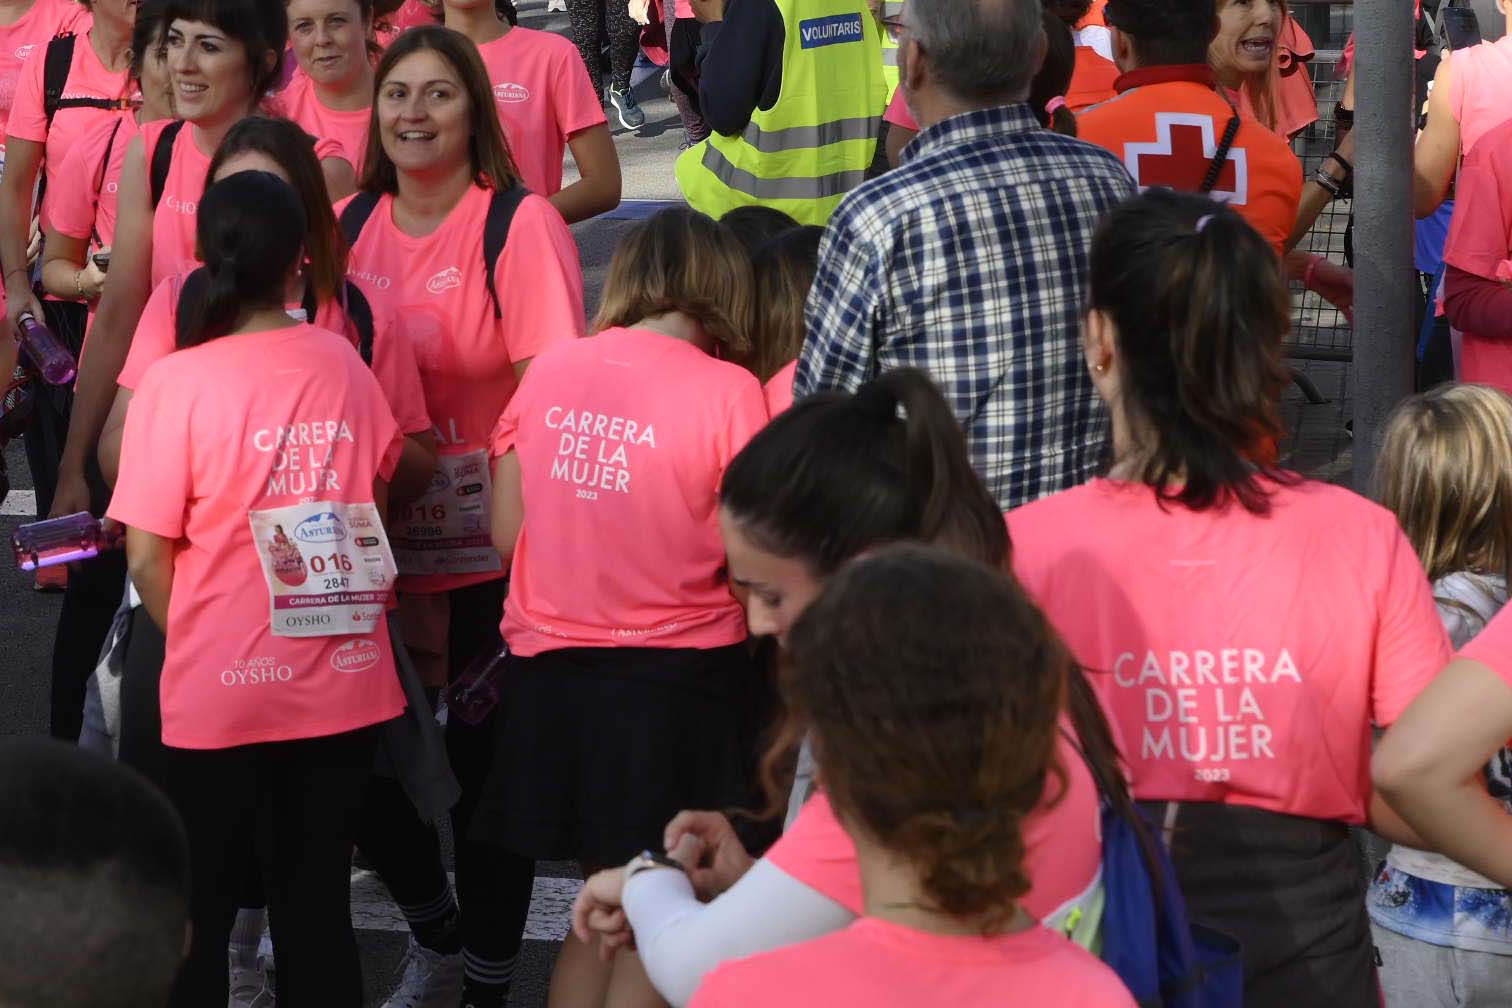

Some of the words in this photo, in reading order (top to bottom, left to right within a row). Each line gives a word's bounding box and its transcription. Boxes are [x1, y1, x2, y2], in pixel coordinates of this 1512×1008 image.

[801, 20, 861, 42] VOLUNTARIS
[254, 419, 354, 451] CARRERA
[545, 405, 656, 448] CARRERA
[273, 447, 300, 471] DE
[309, 445, 333, 469] LA
[558, 433, 591, 456] DE
[597, 438, 629, 467] LA
[266, 469, 341, 497] MUJER
[550, 458, 631, 493] MUJER
[576, 489, 598, 500] 2023
[310, 553, 353, 573] 016
[289, 595, 327, 606] CARRERA
[328, 595, 338, 604] DE
[340, 594, 350, 603] LA
[351, 593, 375, 602] MUJER
[286, 614, 331, 627] OYSHO
[221, 665, 293, 687] OYSHO
[1113, 647, 1303, 688] CARRERA
[1144, 688, 1199, 723] DE
[1215, 686, 1265, 722] LA
[1141, 724, 1275, 762] MUJER
[1194, 768, 1230, 781] 2023
